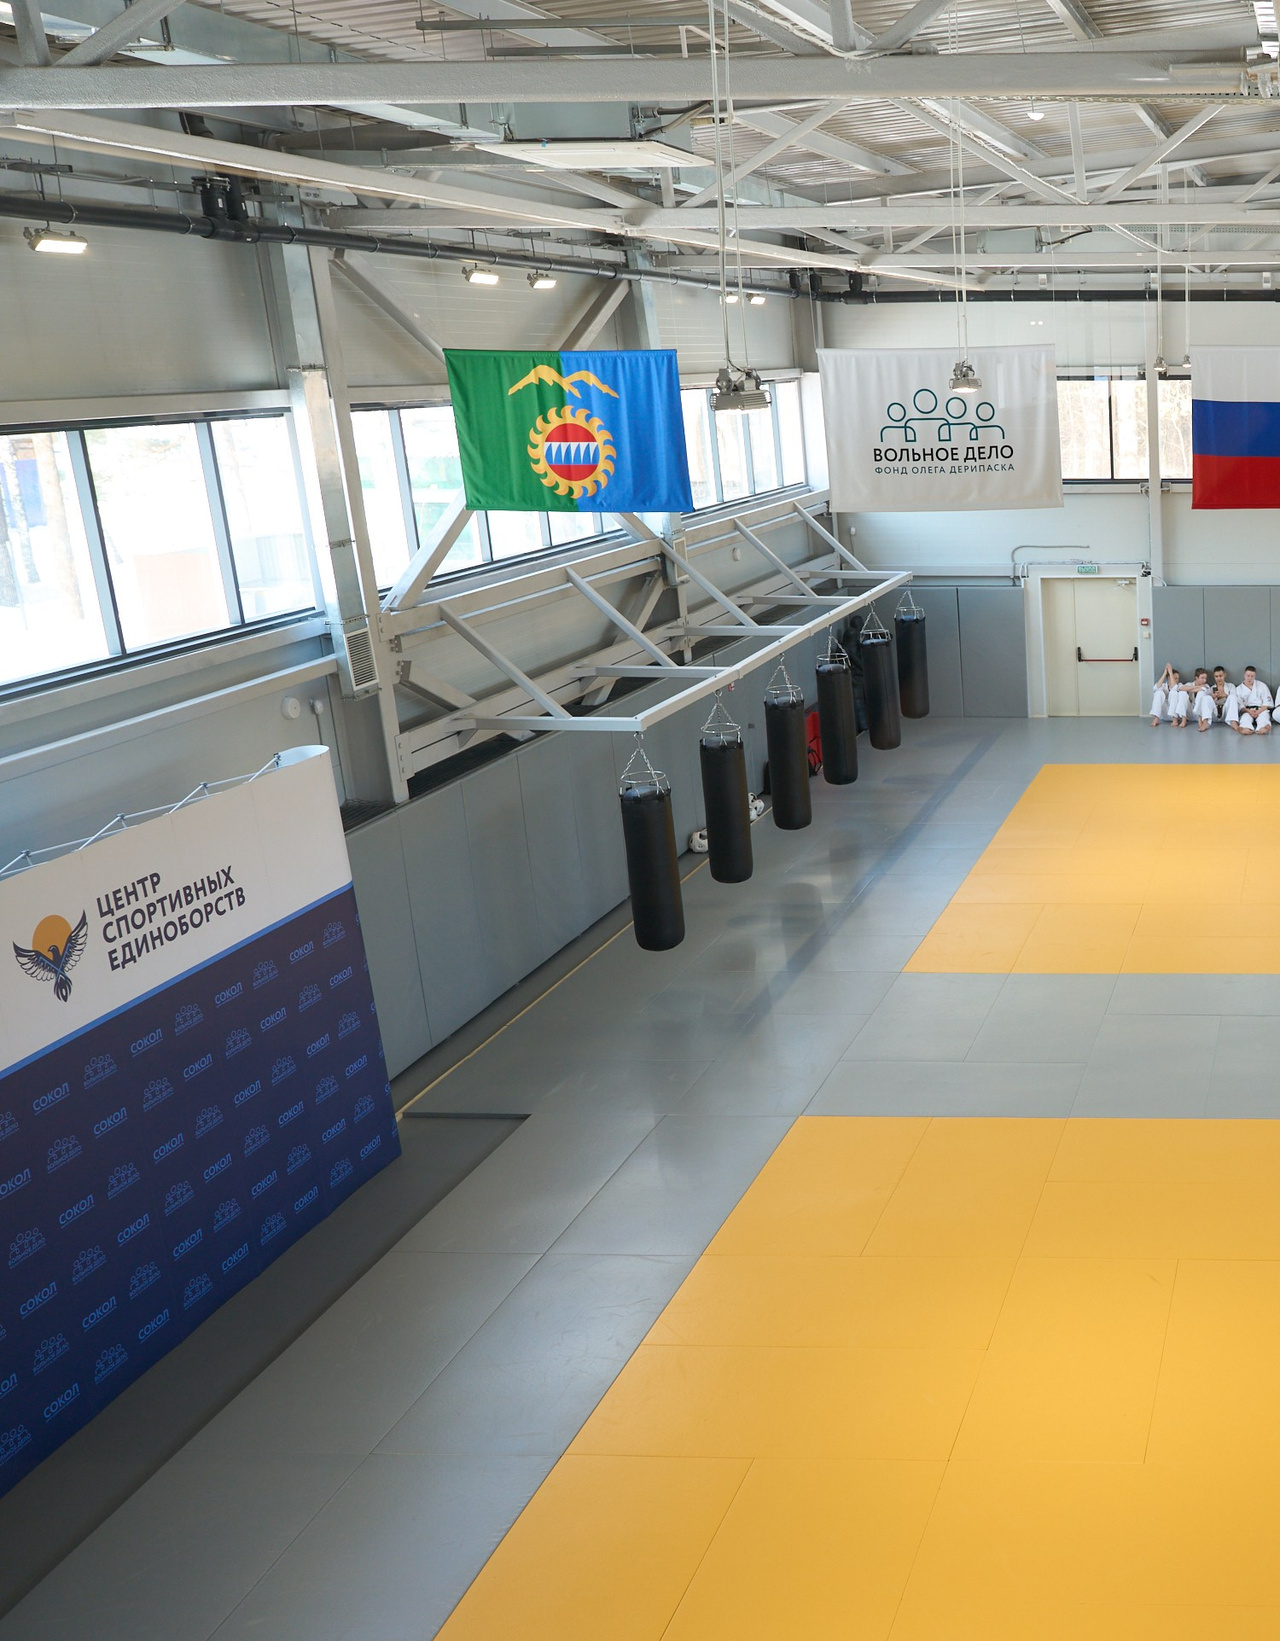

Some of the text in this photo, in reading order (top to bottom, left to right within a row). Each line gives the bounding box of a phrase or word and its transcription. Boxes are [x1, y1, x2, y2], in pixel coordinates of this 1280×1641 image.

[873, 445, 1014, 463] ВОЛЬНОЕ ДЕЛО
[874, 463, 1015, 475] ФОНД ОЛЕГА ДЕРИПАСКА
[96, 872, 161, 918] ЦЕНТР
[102, 865, 235, 943] СПОРТИВНЫХ
[107, 886, 246, 971] ЕДИНОБОРСТВ
[130, 1028, 162, 1054] СОКОЛ
[183, 1054, 212, 1078] СОКОЛ
[32, 1083, 70, 1111] СОКОЛ
[94, 1107, 127, 1134] СОКОЛ
[153, 1133, 184, 1160] СОКОЛ
[204, 1153, 232, 1180] СОКОЛ
[0, 1168, 30, 1195] ОКОЛ
[58, 1194, 94, 1224] СОКОЛ
[117, 1214, 149, 1243] СОКОЛ
[173, 1229, 202, 1257] СОКОЛ
[20, 1282, 57, 1315] СОКОЛ
[82, 1296, 116, 1328] СОКОЛ
[139, 1309, 169, 1340] СОКОЛ
[44, 1382, 79, 1418] СОКОЛ
